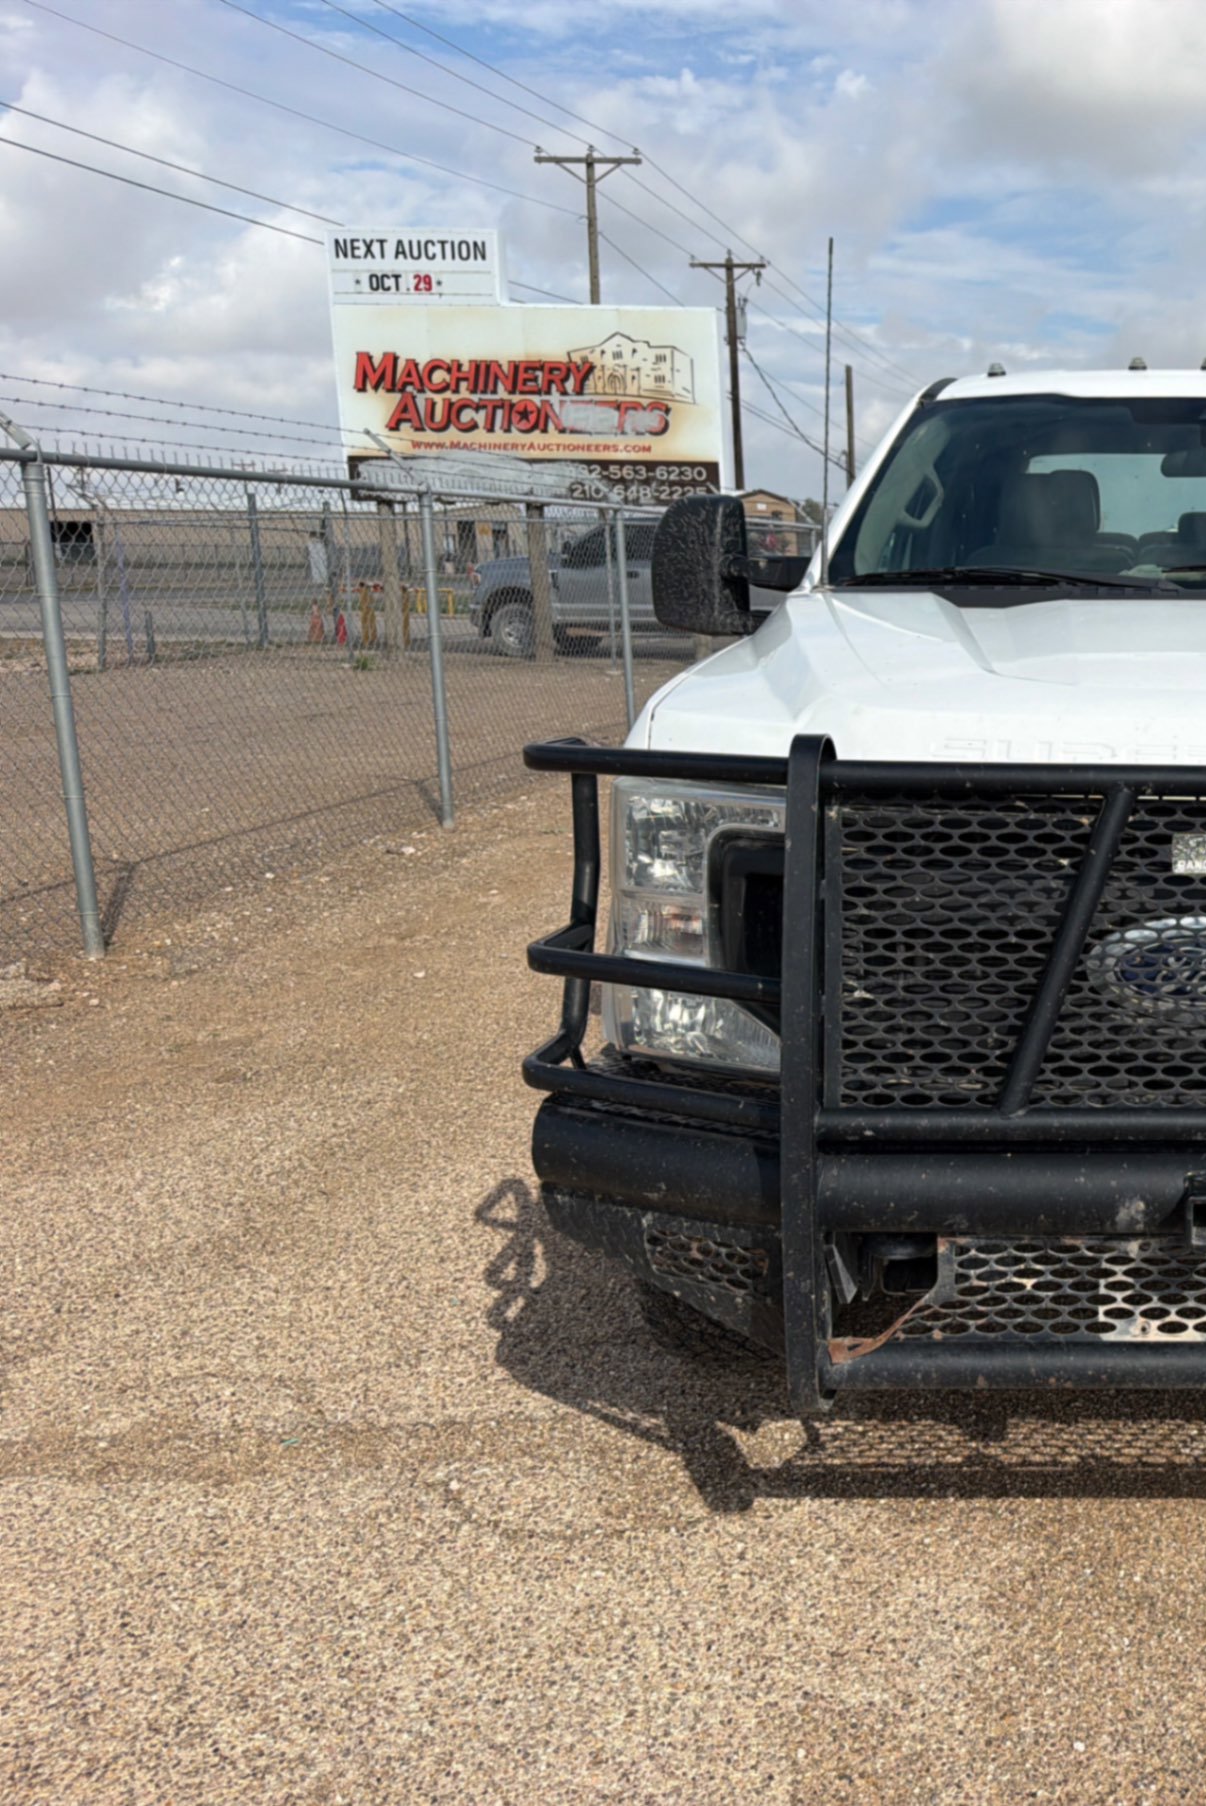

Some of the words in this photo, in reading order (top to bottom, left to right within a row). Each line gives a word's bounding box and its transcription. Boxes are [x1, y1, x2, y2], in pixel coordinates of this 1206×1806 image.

[334, 238, 387, 260] NEXT
[394, 239, 487, 262] AUCTION
[413, 273, 433, 292] 29
[353, 351, 596, 396] MACHINERY
[385, 392, 672, 437] AUCTIONRS
[571, 482, 708, 500] 210648-2225
